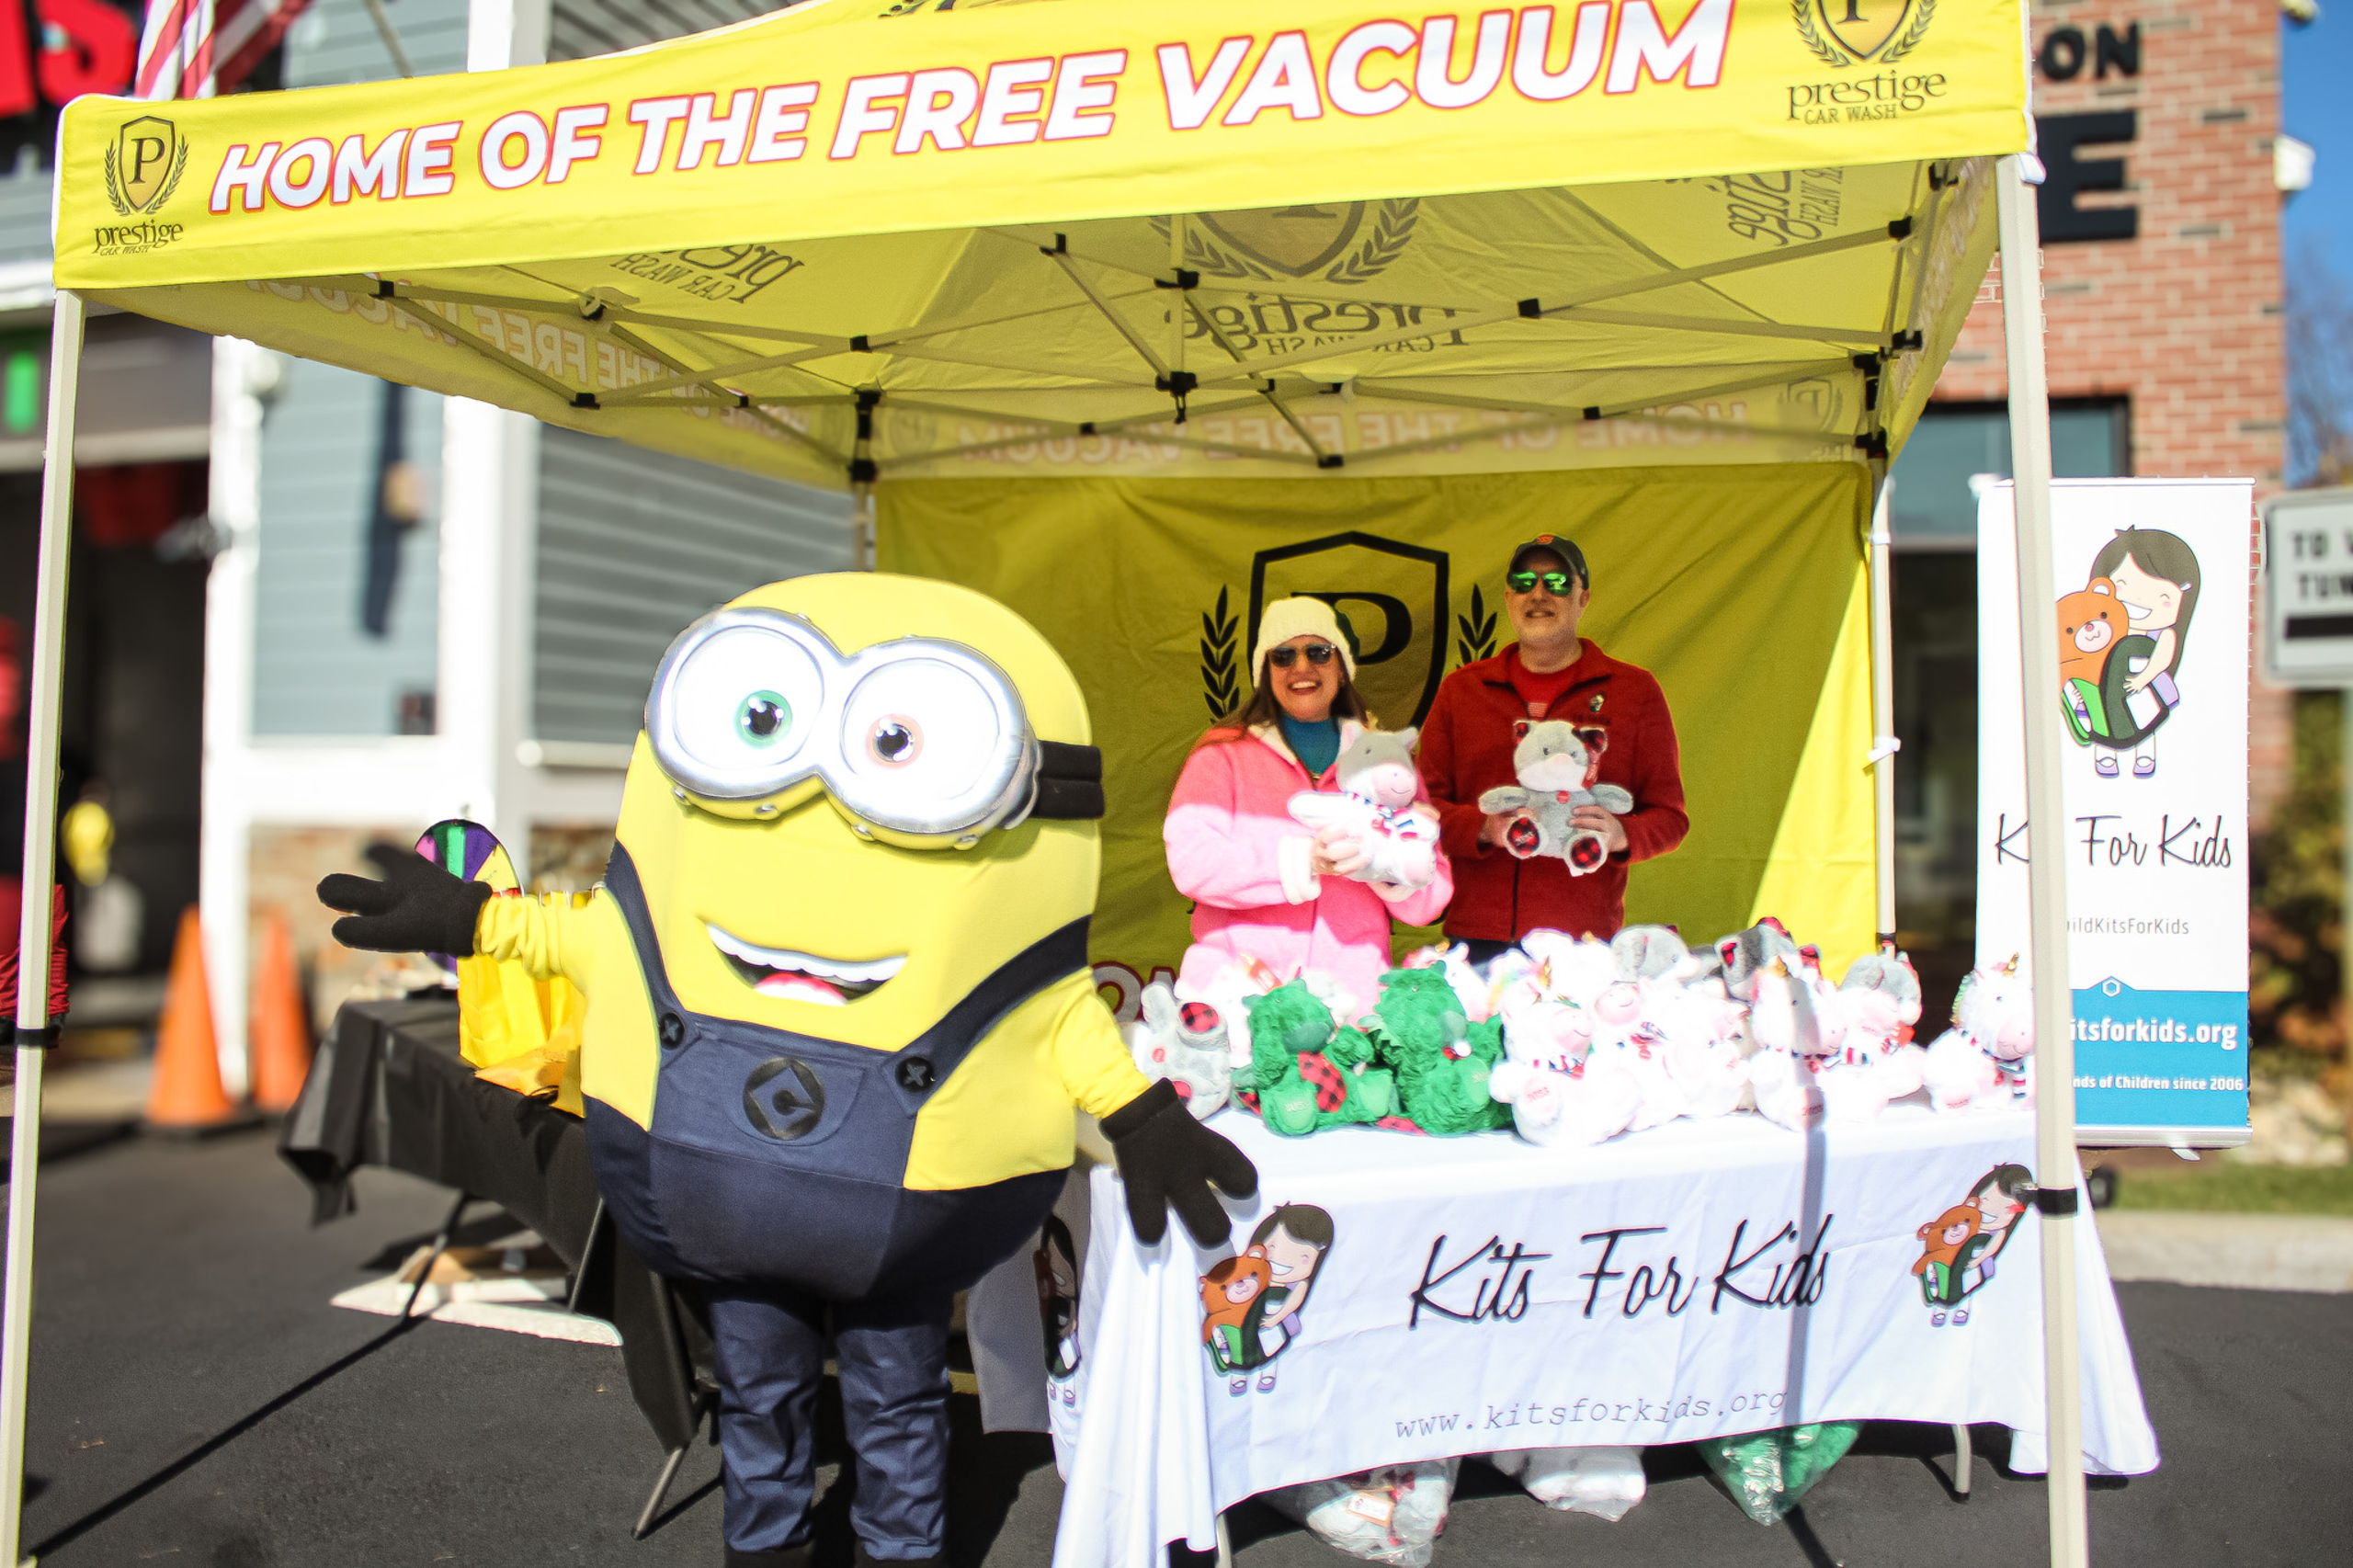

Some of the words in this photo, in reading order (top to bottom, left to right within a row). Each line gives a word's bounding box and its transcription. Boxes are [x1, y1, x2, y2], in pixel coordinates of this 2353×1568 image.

[208, 120, 462, 215] HOME
[478, 103, 609, 189] OF
[630, 81, 820, 175] THE
[828, 49, 1128, 161] FREE
[1155, 0, 1734, 130] VACUUM
[1787, 70, 1947, 120] prestige
[1804, 108, 1839, 125] CAR
[1847, 104, 1898, 121] WASH
[128, 137, 165, 184] P
[92, 219, 184, 254] prestige
[100, 246, 120, 256] CAR
[122, 244, 151, 254] WASH
[2075, 813, 2147, 867] For
[2158, 812, 2232, 869] Kids
[2067, 917, 2189, 935] ildKitsForKids
[2069, 1016, 2239, 1051] itsforkids.org
[2072, 1075, 2097, 1088] nds
[2099, 1075, 2114, 1088] of
[2115, 1075, 2170, 1090] Children
[2173, 1076, 2207, 1091] since
[2210, 1077, 2245, 1092] 2006
[1408, 1233, 1553, 1331] Kits
[1578, 1225, 1700, 1319] For
[1710, 1213, 1836, 1315] Kids
[1395, 1389, 1788, 1439] www.kitsforkids.org
